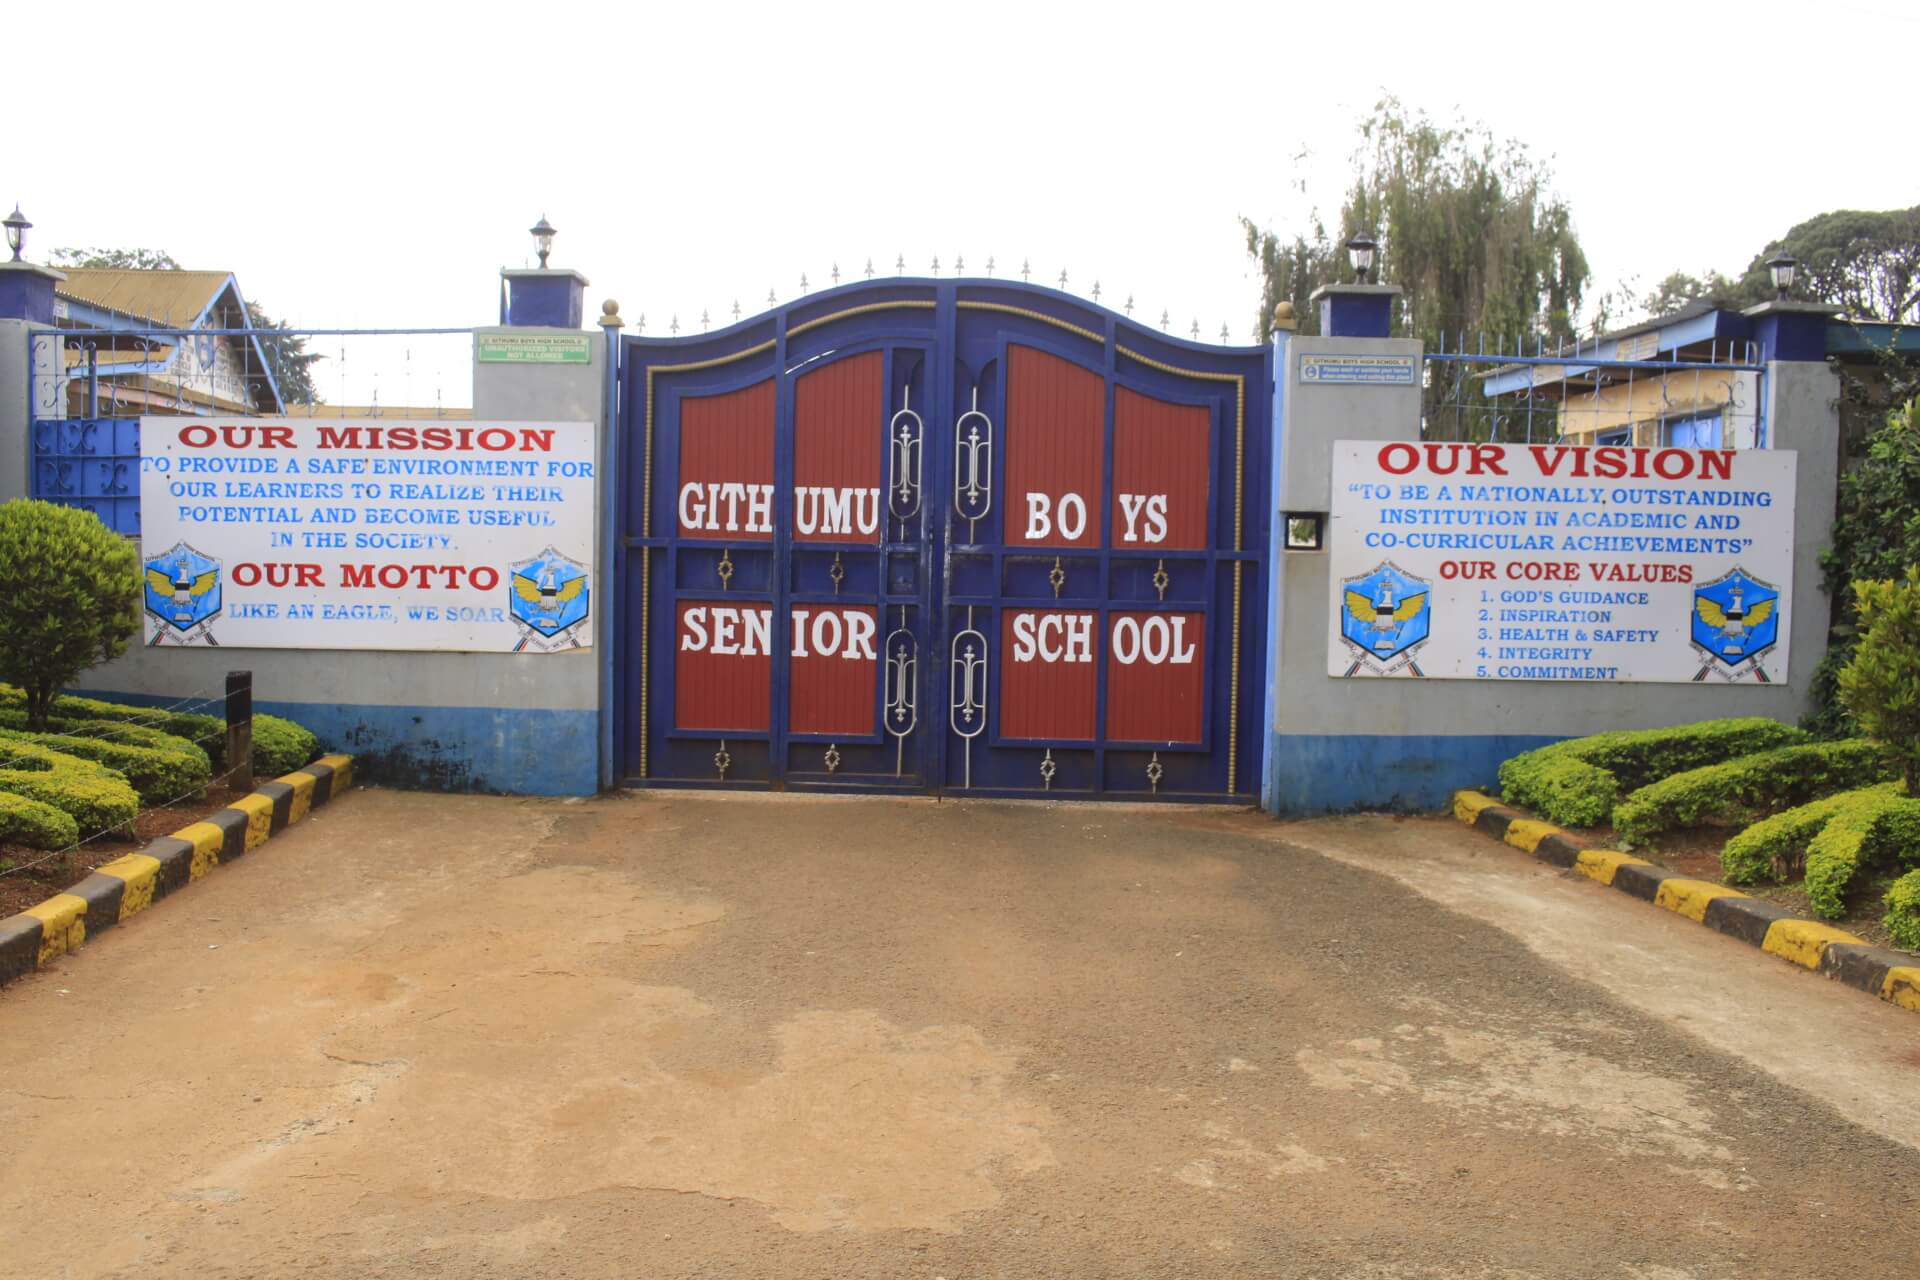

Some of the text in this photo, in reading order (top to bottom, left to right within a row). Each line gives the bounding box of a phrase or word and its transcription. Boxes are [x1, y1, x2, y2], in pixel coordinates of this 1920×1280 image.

[178, 425, 556, 451] OUR MISSION
[140, 457, 594, 478] TO PROVIDE A SAFE ENVIRONMENT FOR
[1377, 443, 1736, 480] OUR VISION
[170, 481, 564, 502] OUR LEARNERS TO REALIZE THEIR
[1400, 485, 1429, 500] BE
[1436, 486, 1453, 501] A
[1460, 486, 1605, 503] NATIONALLY
[1611, 489, 1772, 507] OUTSTANDING
[178, 506, 556, 526] POTENTIAL AND BECOME USEFUL
[1379, 509, 1740, 530] INSTITUTION IN ACADEMIC AND
[271, 532, 293, 548] IN
[302, 532, 348, 548] THE
[1365, 533, 1554, 550] CO-CURRICULAR
[231, 562, 499, 591] OUR MOTTO
[1439, 560, 1496, 579] OUR
[1506, 562, 1580, 581] CORE
[1588, 563, 1693, 583] VALUES
[1481, 590, 1494, 602] 1.
[1559, 591, 1649, 604] GUIDANCE
[229, 603, 505, 624] LIKE AN EAGLE, WE SOAR
[1479, 609, 1611, 623] 2. INSPIRATION
[1478, 628, 1659, 642] 3. HEALTH & SAFETY
[1477, 647, 1592, 661] 4. INTEGRITY
[1476, 666, 1618, 679] 5. COMMITMENT
